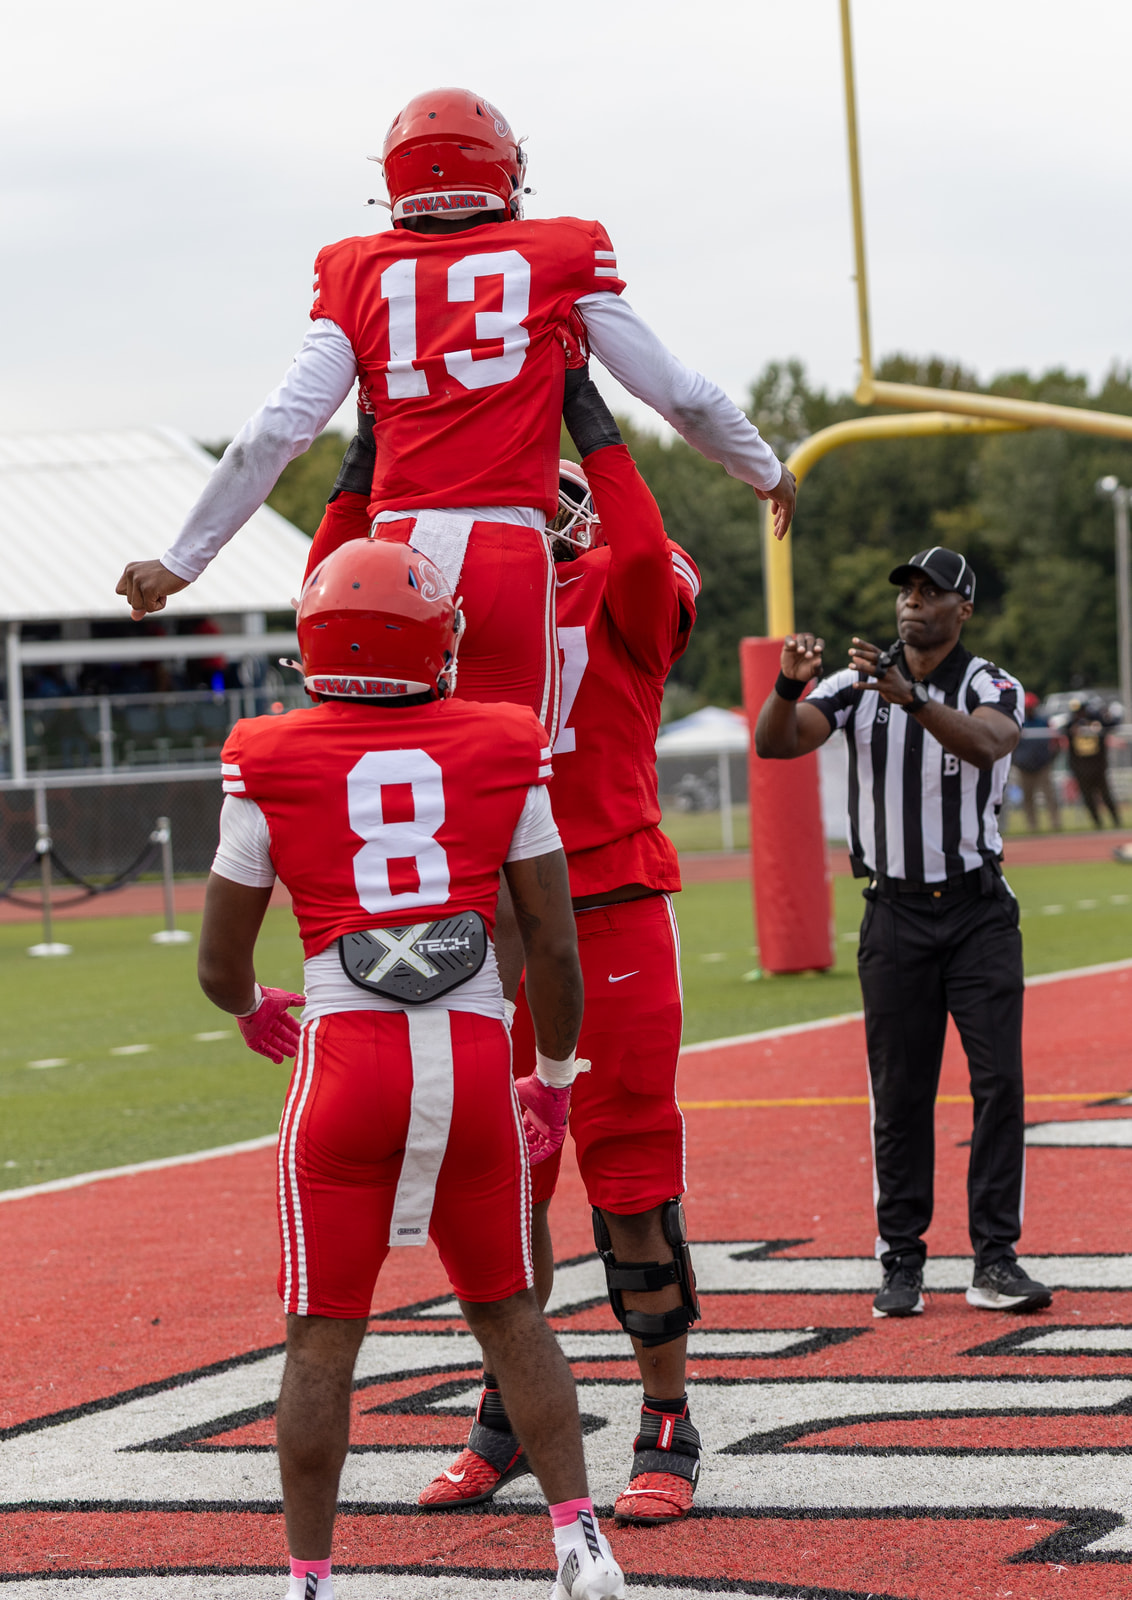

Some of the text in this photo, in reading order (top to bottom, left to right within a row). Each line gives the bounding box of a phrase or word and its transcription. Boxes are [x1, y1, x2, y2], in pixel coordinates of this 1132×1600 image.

[402, 194, 488, 214] SWARM
[381, 250, 531, 400] 13
[313, 679, 408, 695] SWARM
[876, 707, 889, 724] S
[944, 753, 960, 776] B
[347, 748, 451, 914] 8
